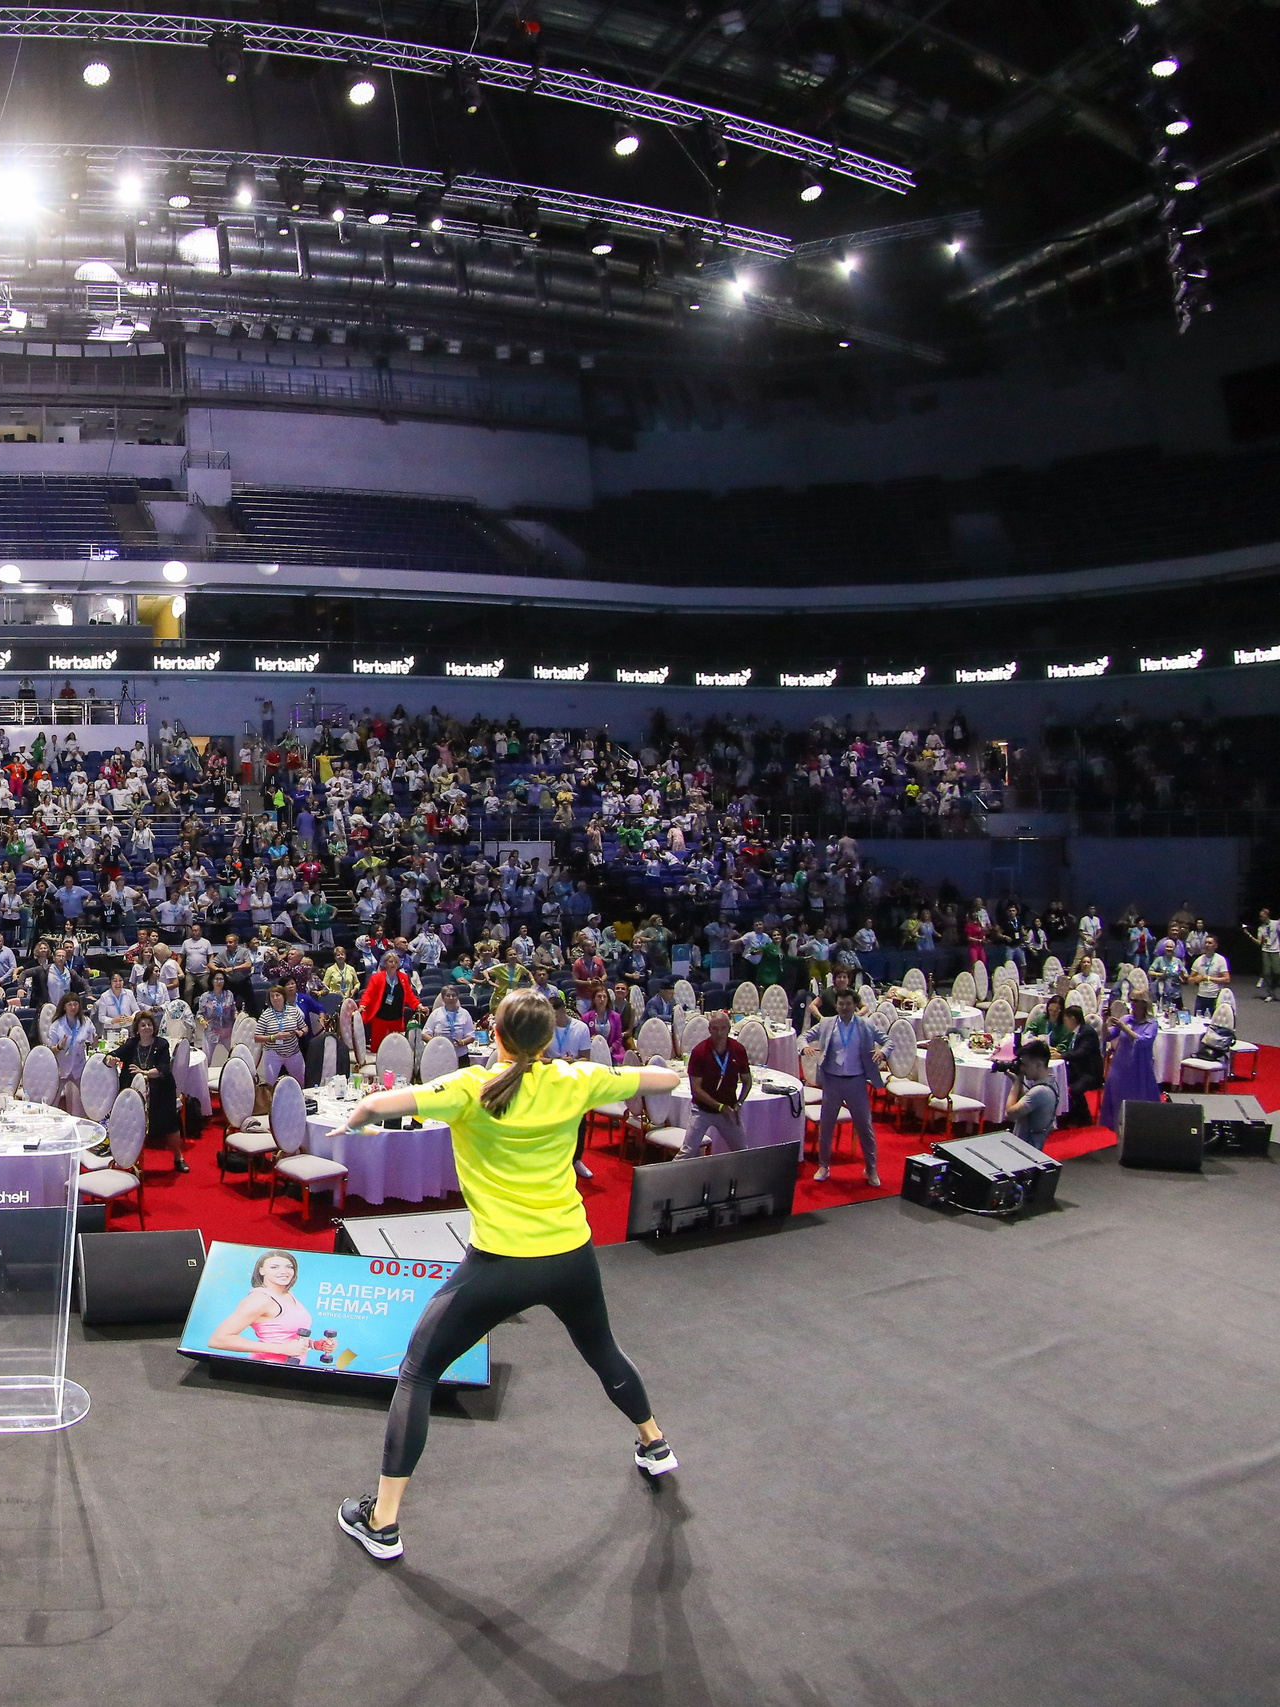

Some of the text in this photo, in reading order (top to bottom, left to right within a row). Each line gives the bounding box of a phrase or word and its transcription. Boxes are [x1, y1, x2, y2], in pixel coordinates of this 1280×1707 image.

[49, 655, 112, 671] Herbalife
[154, 656, 215, 672] Herbalife
[256, 657, 314, 672] Herbalife
[353, 660, 409, 674] Herbalife
[446, 662, 499, 677] Herbalife
[1048, 662, 1104, 678] Herbalife
[1140, 655, 1198, 671] Herbalife
[534, 666, 585, 680] Herbalife
[617, 669, 665, 684] Herbalife
[696, 673, 747, 686] Herbalife
[780, 674, 832, 686] Herbalife
[867, 672, 921, 685] Herbalife
[956, 667, 1012, 682] Herbalife
[370, 1259, 452, 1280] 00:02:
[318, 1281, 415, 1303] ВАЛЕРИЯ
[316, 1297, 389, 1316] НЕМАЯ
